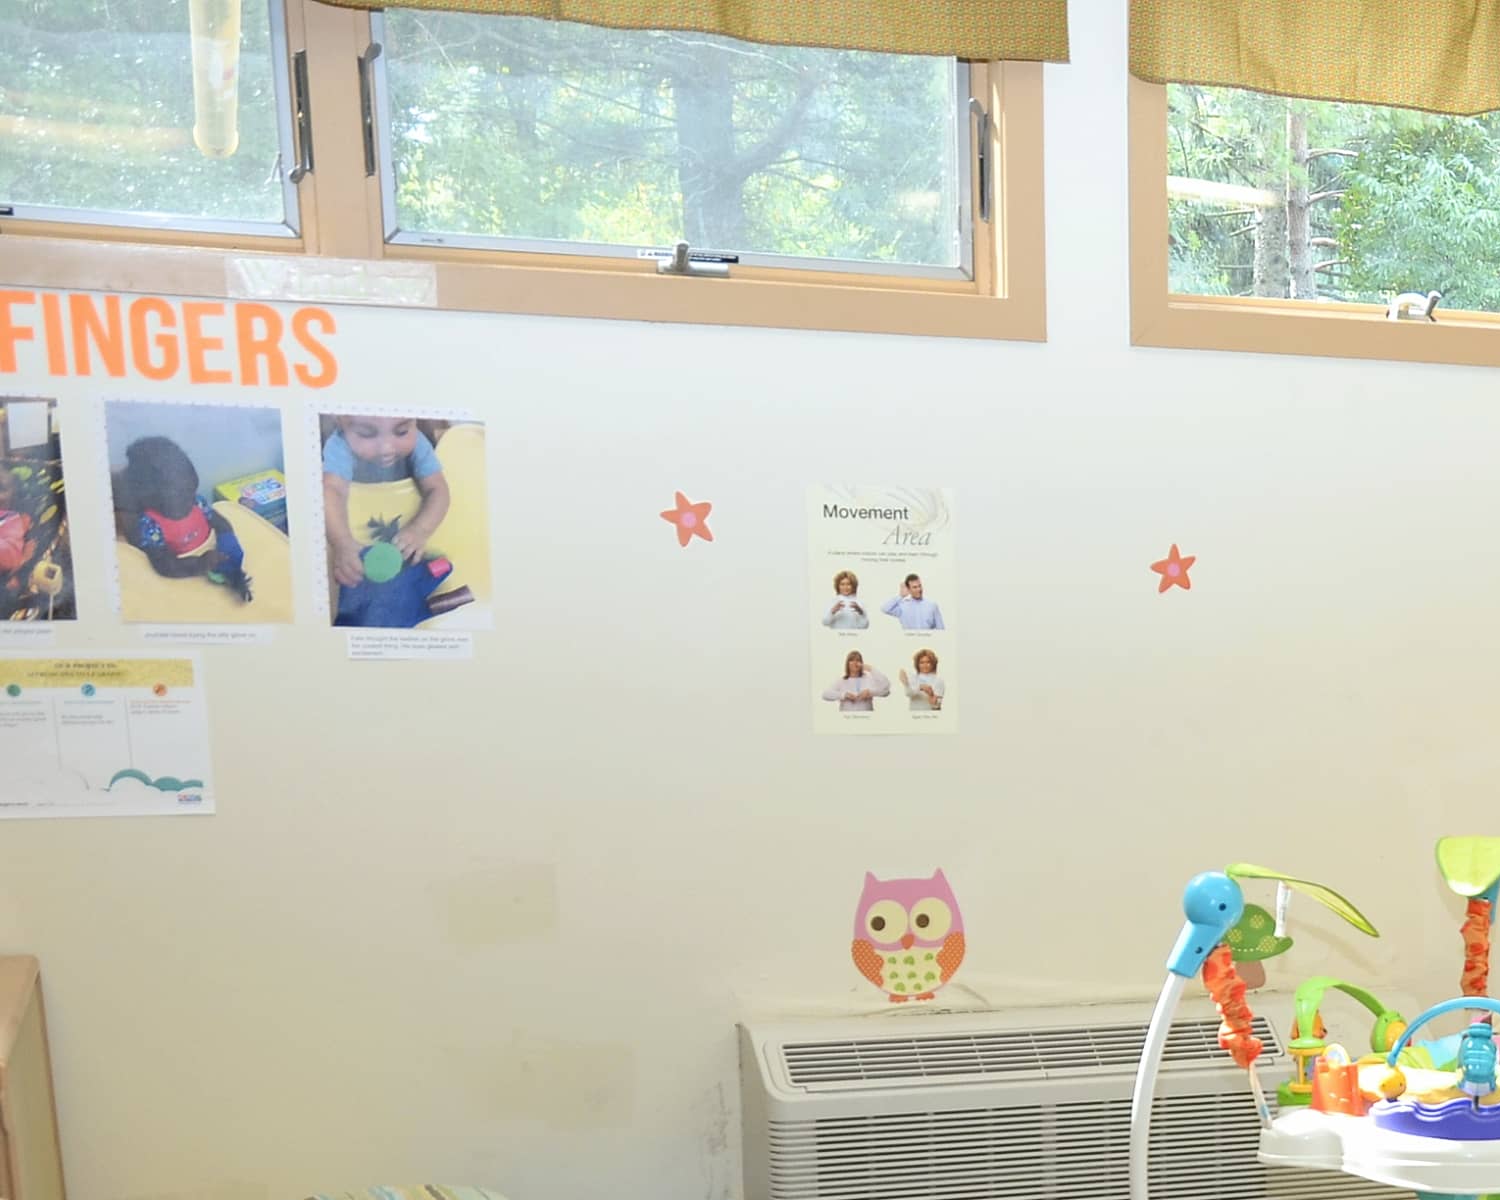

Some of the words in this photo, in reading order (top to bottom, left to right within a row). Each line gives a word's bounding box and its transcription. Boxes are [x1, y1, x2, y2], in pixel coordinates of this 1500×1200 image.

[0, 290, 338, 388] FINGERS
[823, 503, 909, 520] Movement
[881, 524, 932, 546] Area
